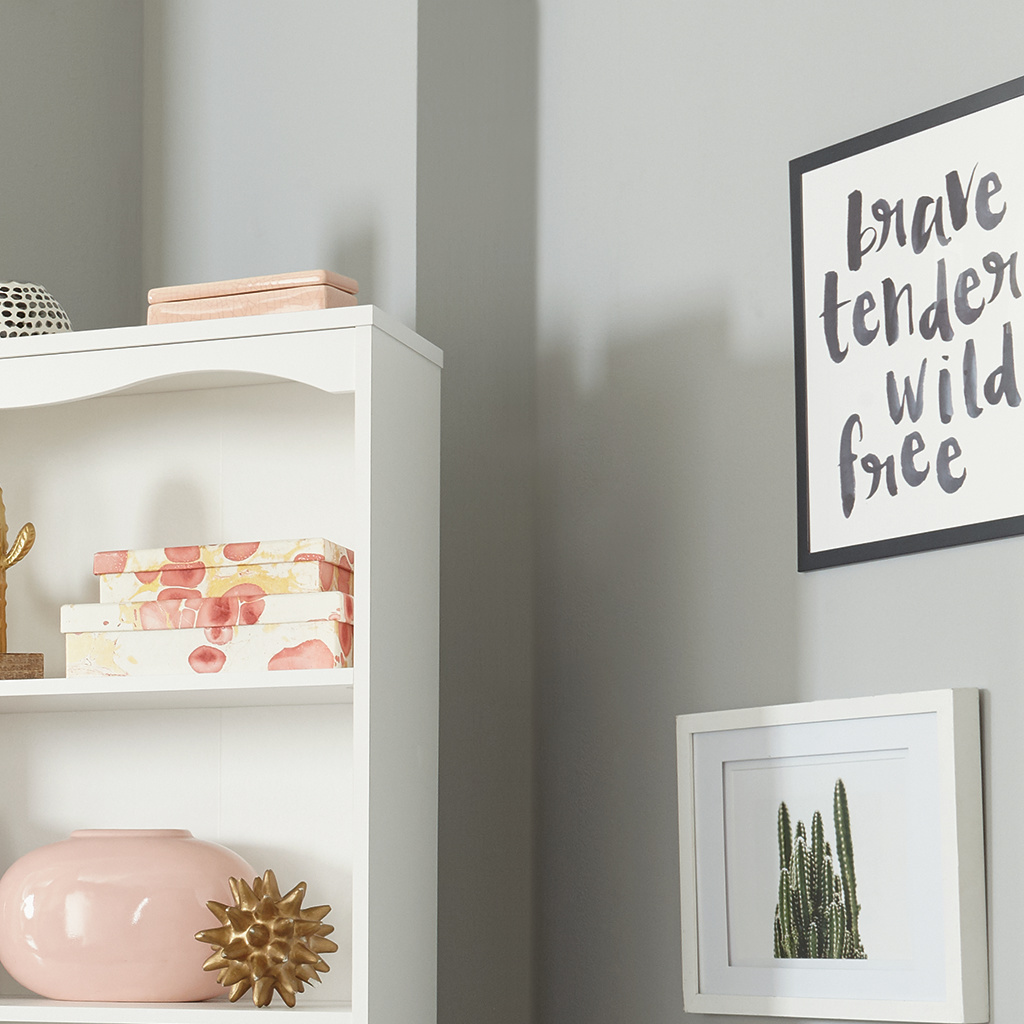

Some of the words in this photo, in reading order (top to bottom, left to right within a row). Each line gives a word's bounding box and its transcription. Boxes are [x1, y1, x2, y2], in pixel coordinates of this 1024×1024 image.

[847, 163, 1007, 271] brave
[819, 252, 1022, 363] tender
[886, 322, 1022, 424] wild
[838, 414, 966, 519] free
